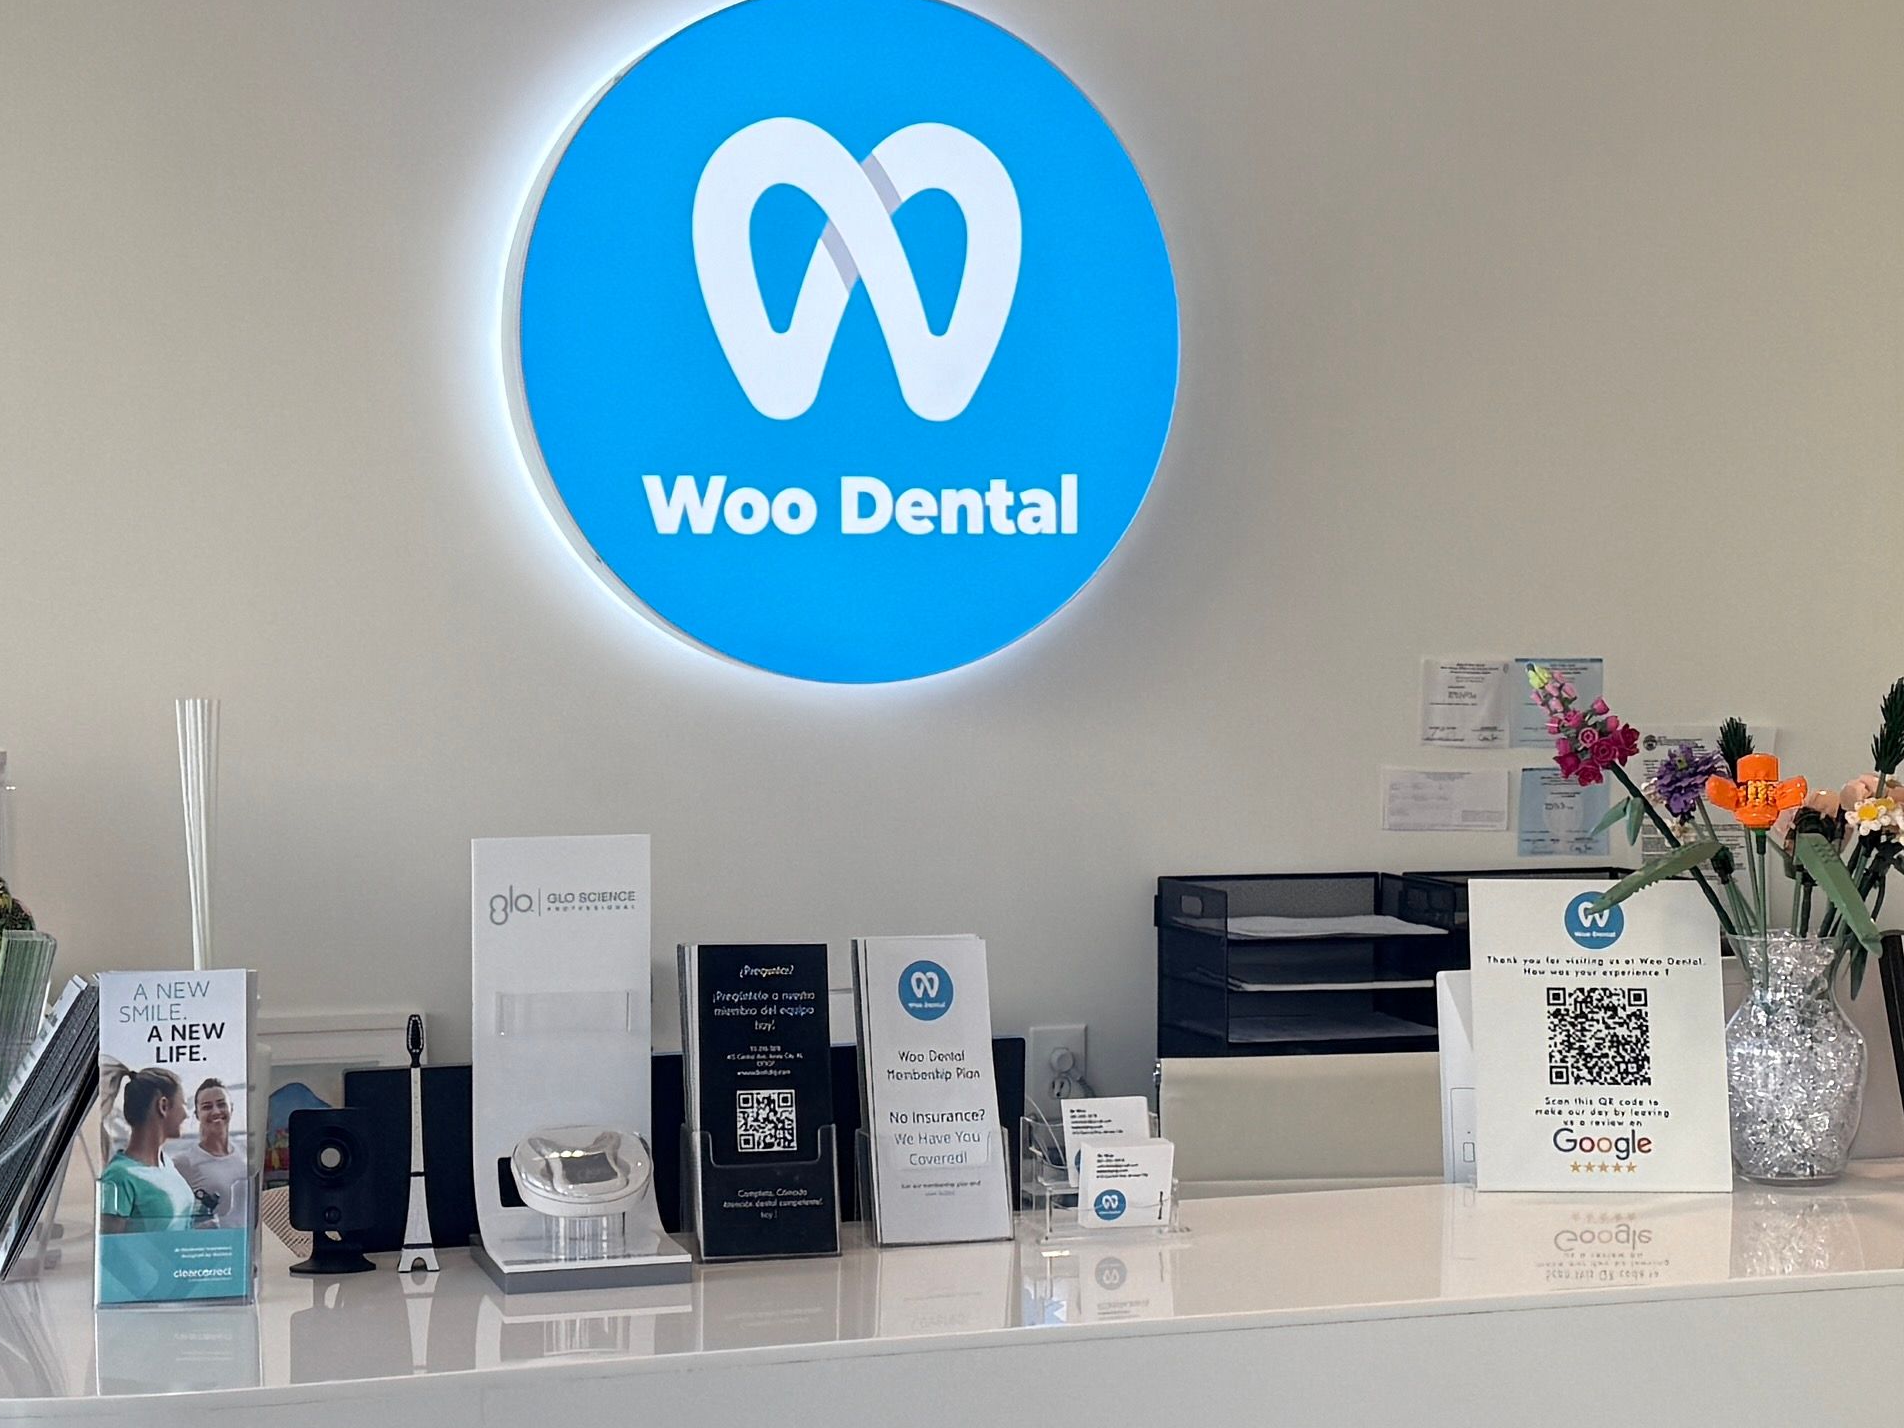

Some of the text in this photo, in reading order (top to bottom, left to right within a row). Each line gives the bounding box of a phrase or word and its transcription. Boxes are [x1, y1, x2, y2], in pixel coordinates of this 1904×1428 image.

[641, 473, 1078, 534] Woo Dental
[547, 891, 636, 904] GLO SCIENCE
[1487, 955, 1517, 964] Thank
[1522, 957, 1541, 966] you
[1545, 955, 1560, 964] for
[1566, 955, 1604, 966] visiting
[1624, 957, 1634, 965] at
[1639, 957, 1663, 965] Woo
[1575, 969, 1597, 977] your
[1602, 968, 1660, 977] experience
[133, 980, 210, 1001] A NEW
[119, 1003, 187, 1023] SMILE.
[147, 1022, 225, 1043] A NEW
[156, 1044, 207, 1063] LIFE.
[898, 1049, 965, 1062] Woo Dental
[887, 1067, 981, 1082] Membership Plan
[1545, 1097, 1659, 1106] Scan this QR code to
[889, 1108, 985, 1124] No Insurance?
[1535, 1108, 1563, 1116] make
[1590, 1108, 1609, 1117] day
[1614, 1108, 1625, 1117] by
[1630, 1108, 1670, 1118] leaving
[895, 1131, 981, 1145] We Have You
[1552, 1127, 1653, 1161] Google
[909, 1151, 968, 1166] Covered!
